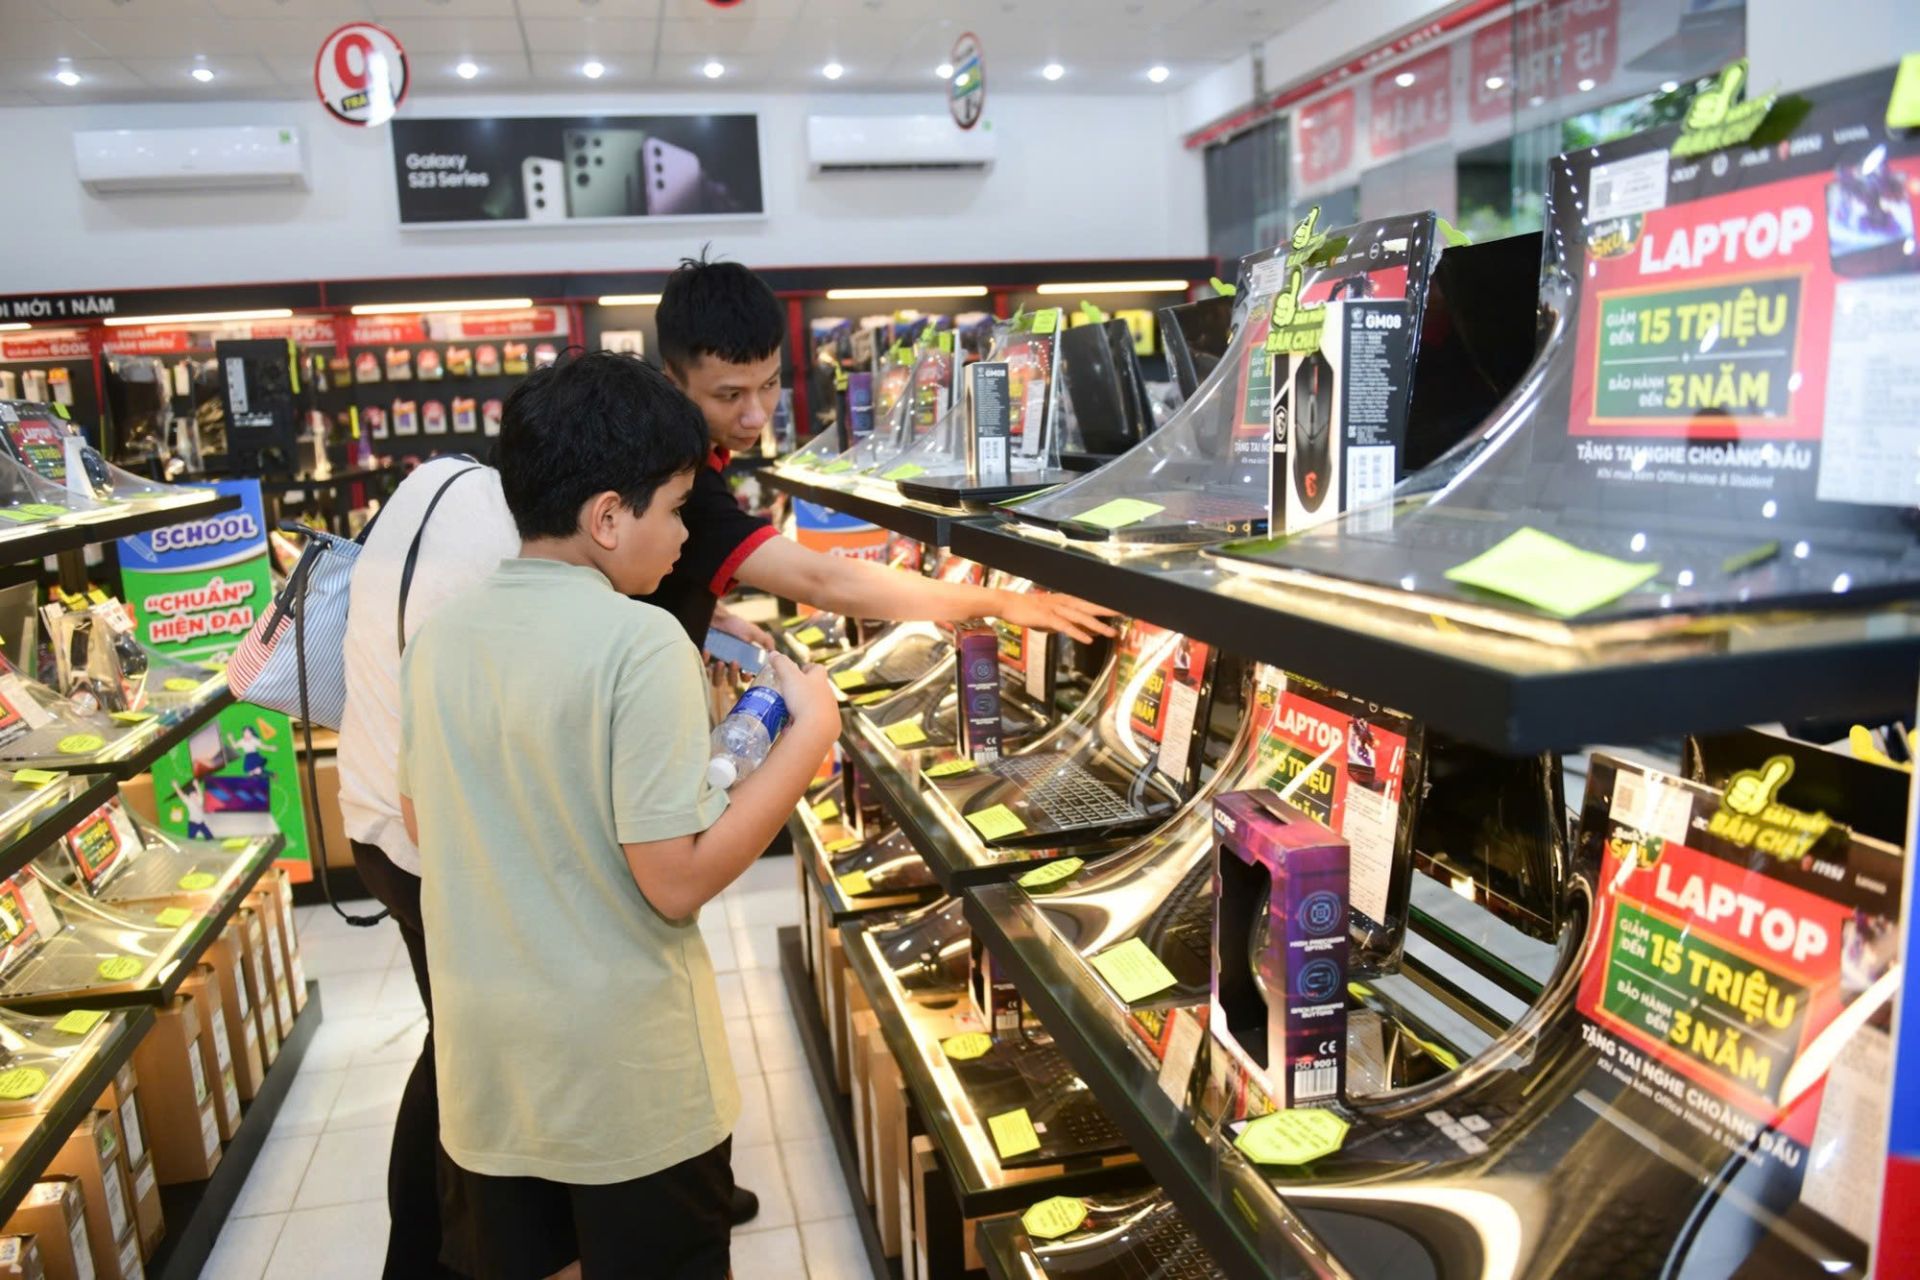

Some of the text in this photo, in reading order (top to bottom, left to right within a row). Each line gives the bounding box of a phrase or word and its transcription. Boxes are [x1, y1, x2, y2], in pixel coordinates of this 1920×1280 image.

[405, 152, 467, 171] Galaxy
[408, 170, 490, 189] S23 Series
[1639, 205, 1813, 275] LAPTOP
[14, 298, 51, 317] MỚI
[56, 301, 66, 315] 1
[72, 296, 116, 315] NĂM
[1606, 307, 1637, 328] GIẢM
[1638, 287, 1788, 348] 15 TRIỆU
[1365, 313, 1402, 330] GM08
[1608, 328, 1635, 347] ĐẾN
[1665, 362, 1770, 409] 3 NĂM
[1638, 392, 1664, 408] ĐẾN
[1576, 440, 1614, 464] TẶNG
[154, 517, 256, 550] SCHOOL
[152, 608, 252, 641] HIỆN ĐẠI
[1274, 703, 1344, 748] LAPTOP
[1709, 811, 1760, 845] BÁN
[1655, 863, 1829, 962] LAPTOP
[1620, 918, 1649, 942] GIẢM
[1620, 936, 1647, 960] ĐẾN
[1650, 933, 1797, 1029] 15 TRIỆU
[1617, 979, 1673, 1017] BẢO HÀNH
[1645, 1011, 1670, 1034] ĐẾN
[1670, 1008, 1772, 1090] 3 NĂM
[1313, 1057, 1337, 1069] 9001
[1596, 1057, 1613, 1073] Khi
[1582, 1023, 1616, 1057] TẶNG
[1618, 1045, 1641, 1072] TAI
[1641, 1060, 1686, 1099] NGHE
[1686, 1088, 1758, 1142] CHOÀNG
